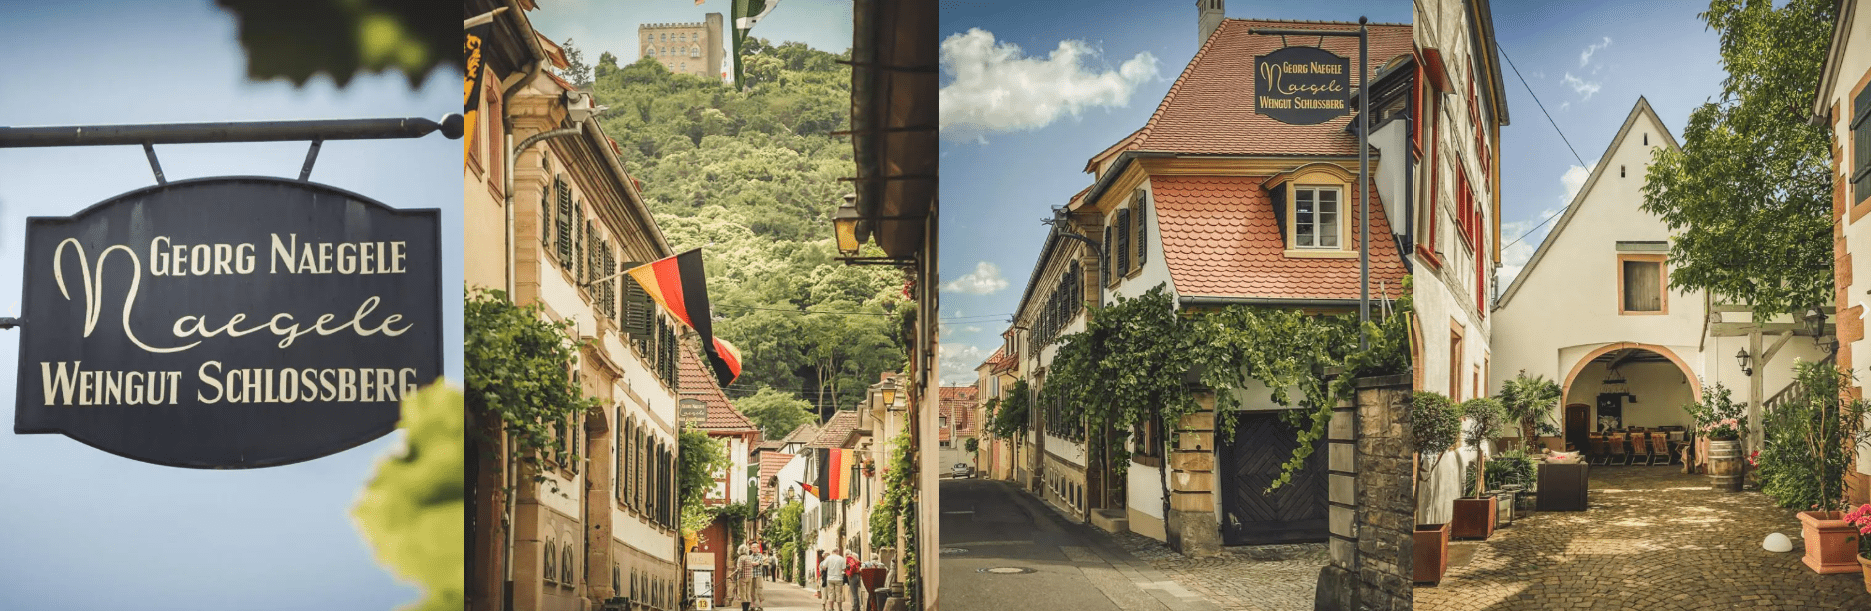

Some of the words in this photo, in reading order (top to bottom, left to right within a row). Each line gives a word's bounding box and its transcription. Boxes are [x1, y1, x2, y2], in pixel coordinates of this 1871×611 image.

[1283, 61, 1308, 73] GEORG
[1311, 61, 1342, 74] NAEGELE
[1260, 96, 1291, 108] WEINGUT
[1295, 96, 1344, 109] SCHLOSSBERG
[150, 236, 256, 276] GEORG
[270, 233, 407, 275] NAEGELE
[53, 237, 414, 353] Naegele
[40, 361, 182, 406] WEINGUT
[197, 360, 418, 404] SCHLOSSBERG
